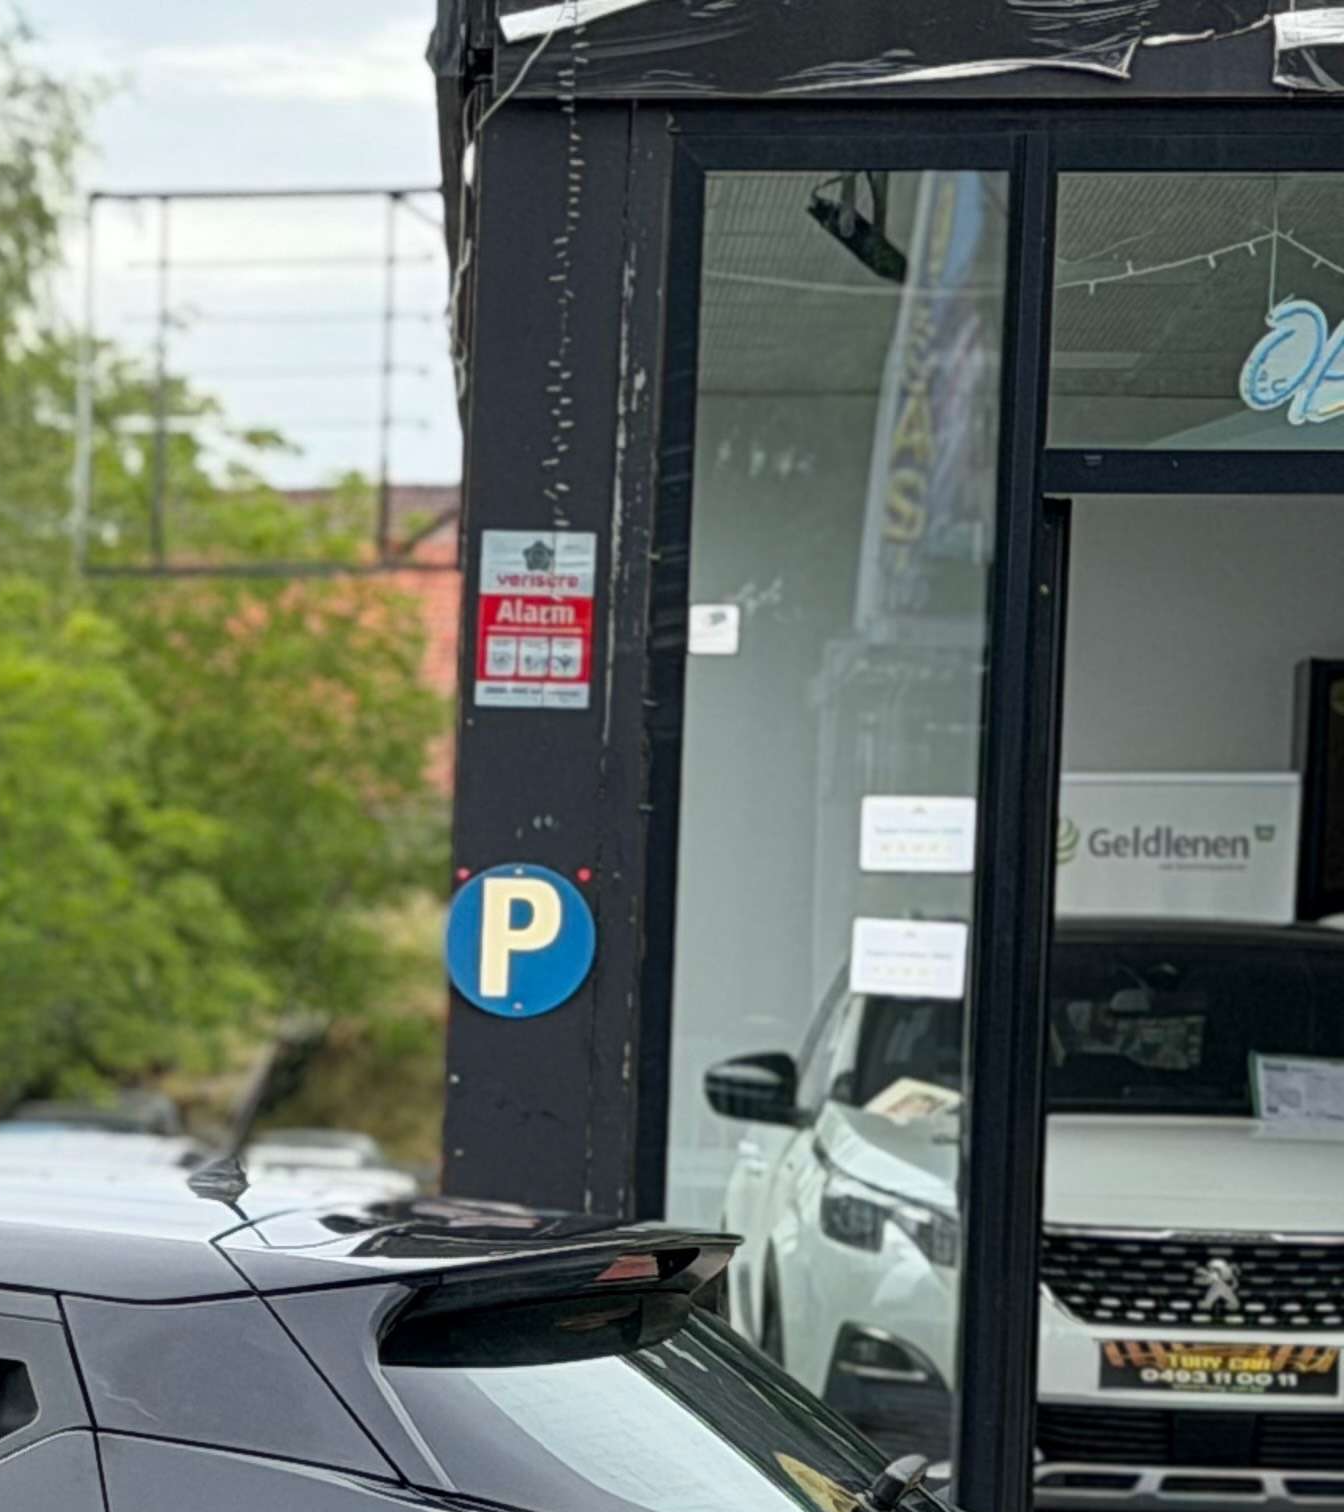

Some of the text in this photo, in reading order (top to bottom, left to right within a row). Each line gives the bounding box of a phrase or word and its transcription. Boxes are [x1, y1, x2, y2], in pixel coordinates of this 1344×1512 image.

[496, 599, 576, 625] Alarm
[1088, 826, 1250, 859] Geldlenen
[479, 877, 562, 998] P
